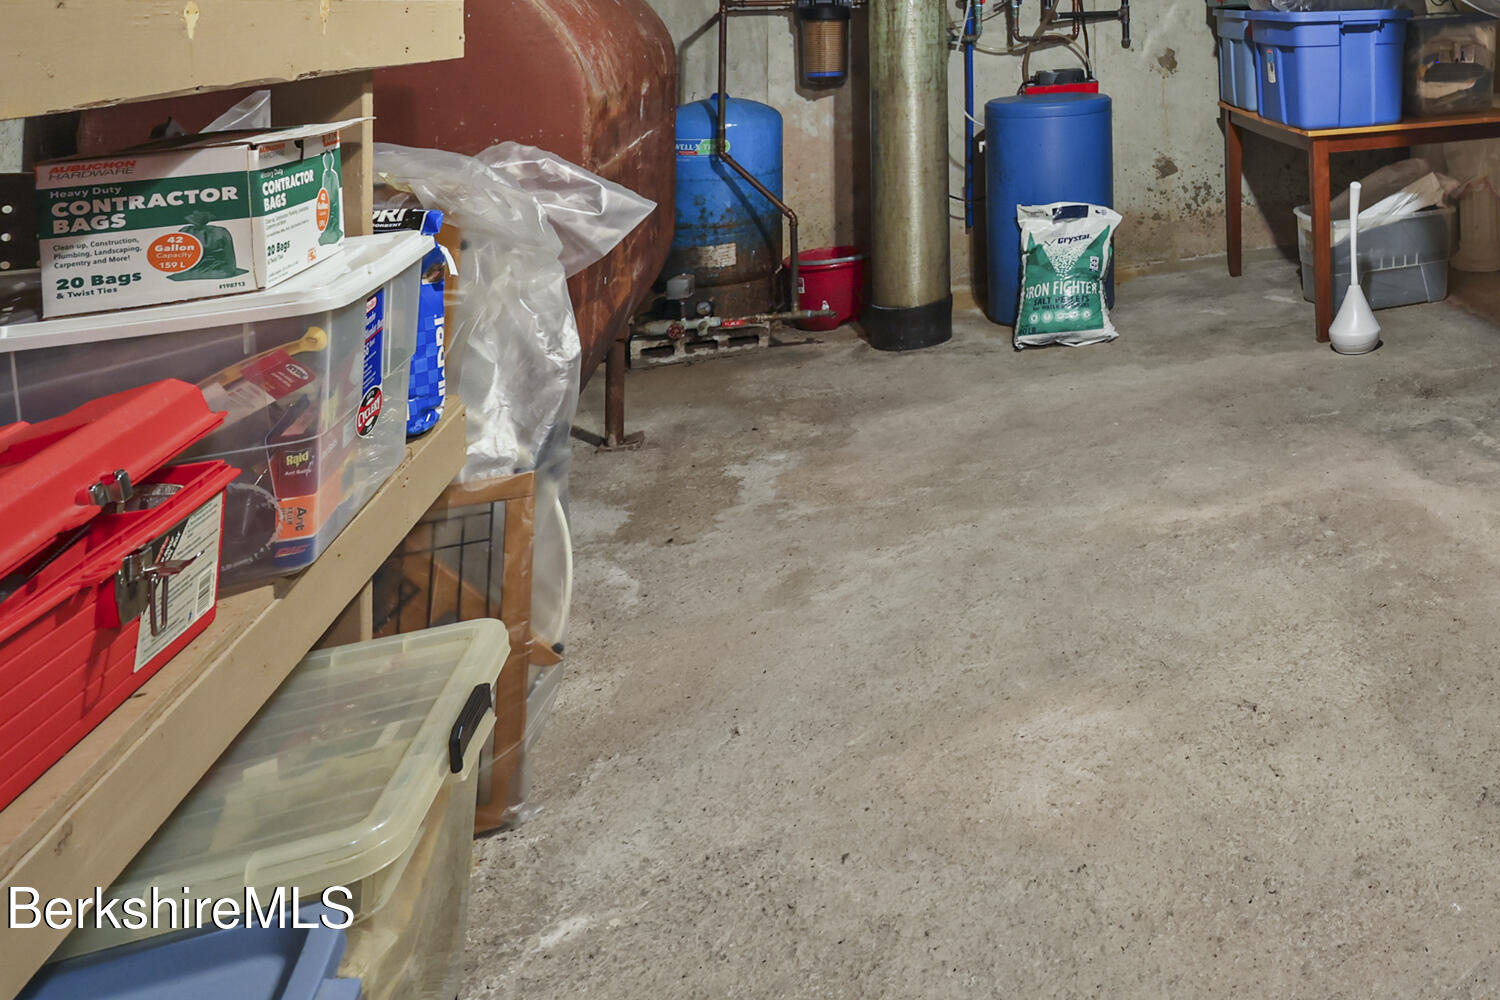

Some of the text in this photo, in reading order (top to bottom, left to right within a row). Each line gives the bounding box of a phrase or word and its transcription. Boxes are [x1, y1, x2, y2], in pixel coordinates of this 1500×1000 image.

[49, 160, 136, 173] AUBUCHON
[49, 166, 135, 181] HARDWARE
[262, 169, 315, 197] CONTRACTOR
[50, 186, 122, 199] Heavy Duty
[51, 186, 239, 217] CONTRACTOR
[263, 192, 287, 212] BAGS
[52, 213, 127, 234] BAGS
[90, 236, 139, 248] Construction,
[167, 235, 184, 244] 42
[1057, 233, 1091, 244] Crystal
[94, 245, 142, 257] Landscaping,
[155, 243, 195, 252] Gallon
[267, 240, 291, 257] 20 Bags
[155, 251, 192, 259] Capacity
[54, 259, 91, 270] Carpentry
[93, 257, 107, 266] and
[159, 260, 186, 269] 159 L
[56, 272, 142, 291] 20 Bags
[68, 289, 94, 299] Twist
[96, 286, 118, 296] Ties
[1026, 280, 1098, 299] IRON FIGHTER
[1034, 297, 1051, 306] SALT
[286, 450, 309, 466] Raid
[295, 507, 307, 531] Ant
